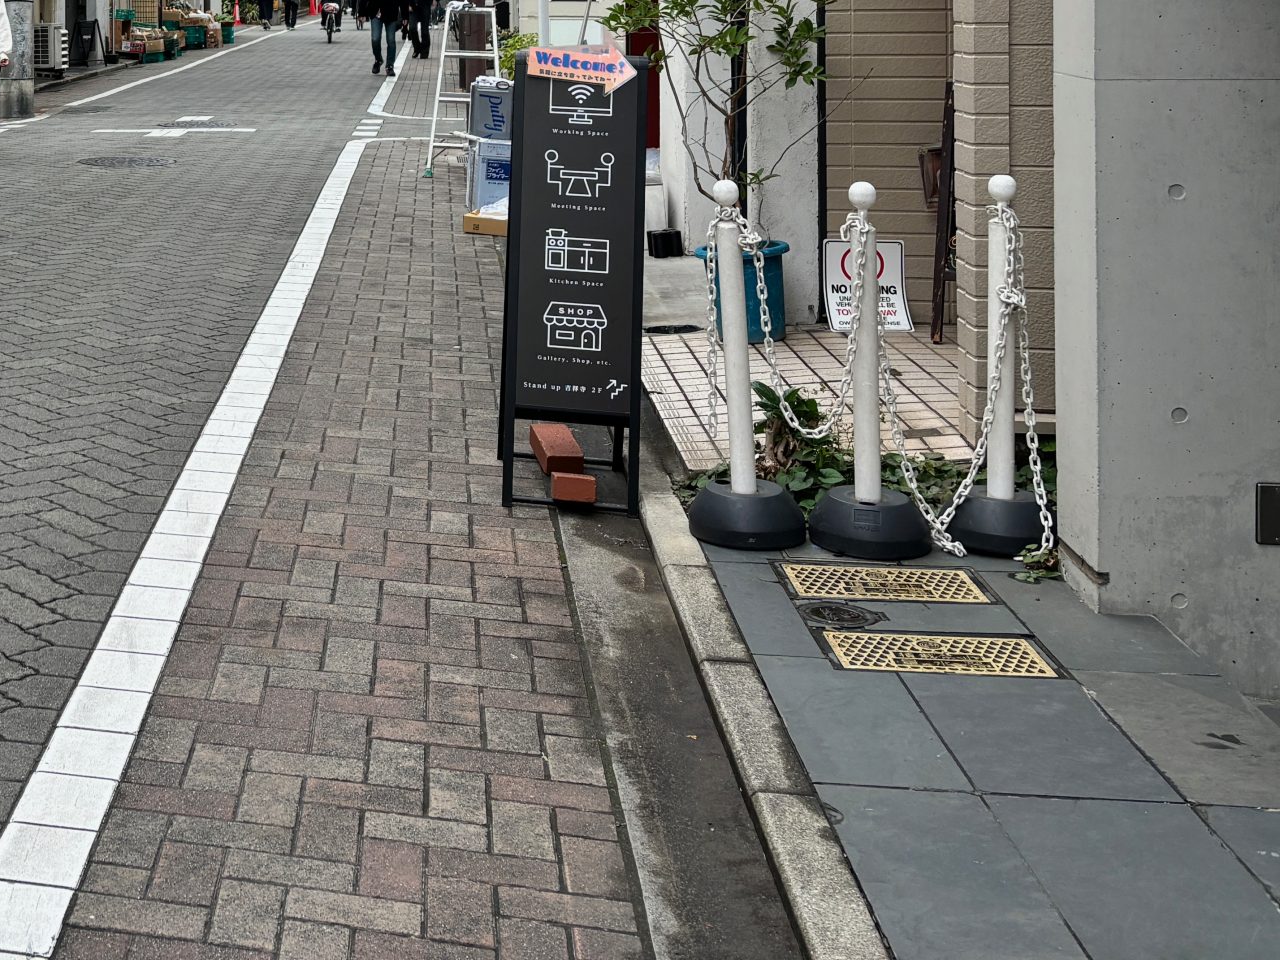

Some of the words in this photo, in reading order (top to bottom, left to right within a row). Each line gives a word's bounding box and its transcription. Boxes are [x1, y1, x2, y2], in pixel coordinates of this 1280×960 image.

[535, 50, 625, 74] Welcome!
[552, 128, 584, 136] Working
[551, 203, 581, 211] Meeting
[584, 204, 606, 212] Space
[831, 284, 847, 294] NO
[558, 307, 594, 315] SHOP
[537, 354, 569, 363] Gallery,
[572, 357, 593, 365] Shop,
[523, 381, 547, 389] Stand
[565, 384, 586, 393] 吉祥寺
